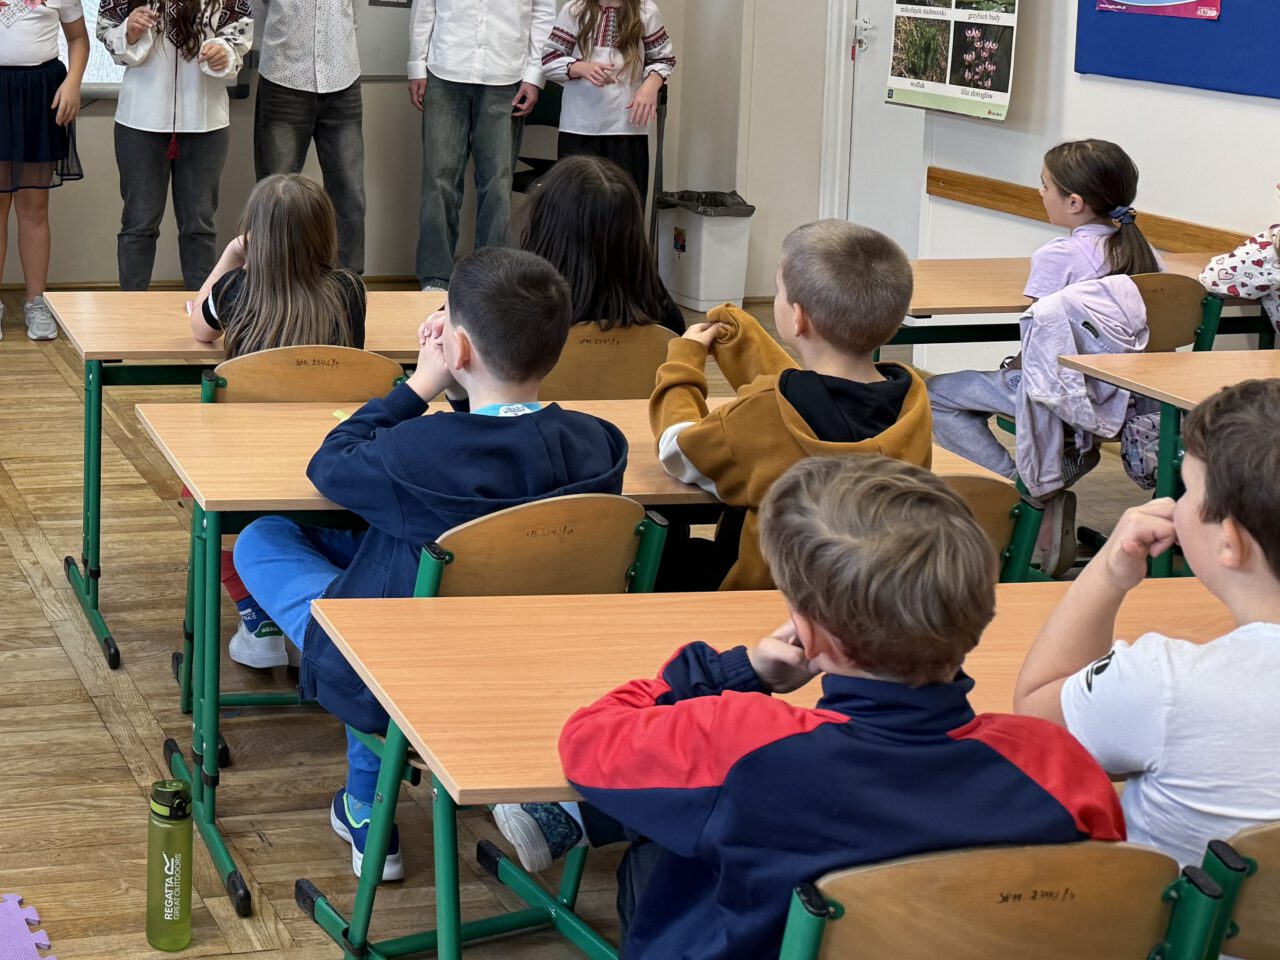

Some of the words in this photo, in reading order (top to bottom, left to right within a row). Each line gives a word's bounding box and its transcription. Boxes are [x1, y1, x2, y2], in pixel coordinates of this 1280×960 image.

[173, 853, 182, 897] OUTDOORS
[164, 876, 174, 921] REGATTA
[173, 897, 181, 921] GREAT
